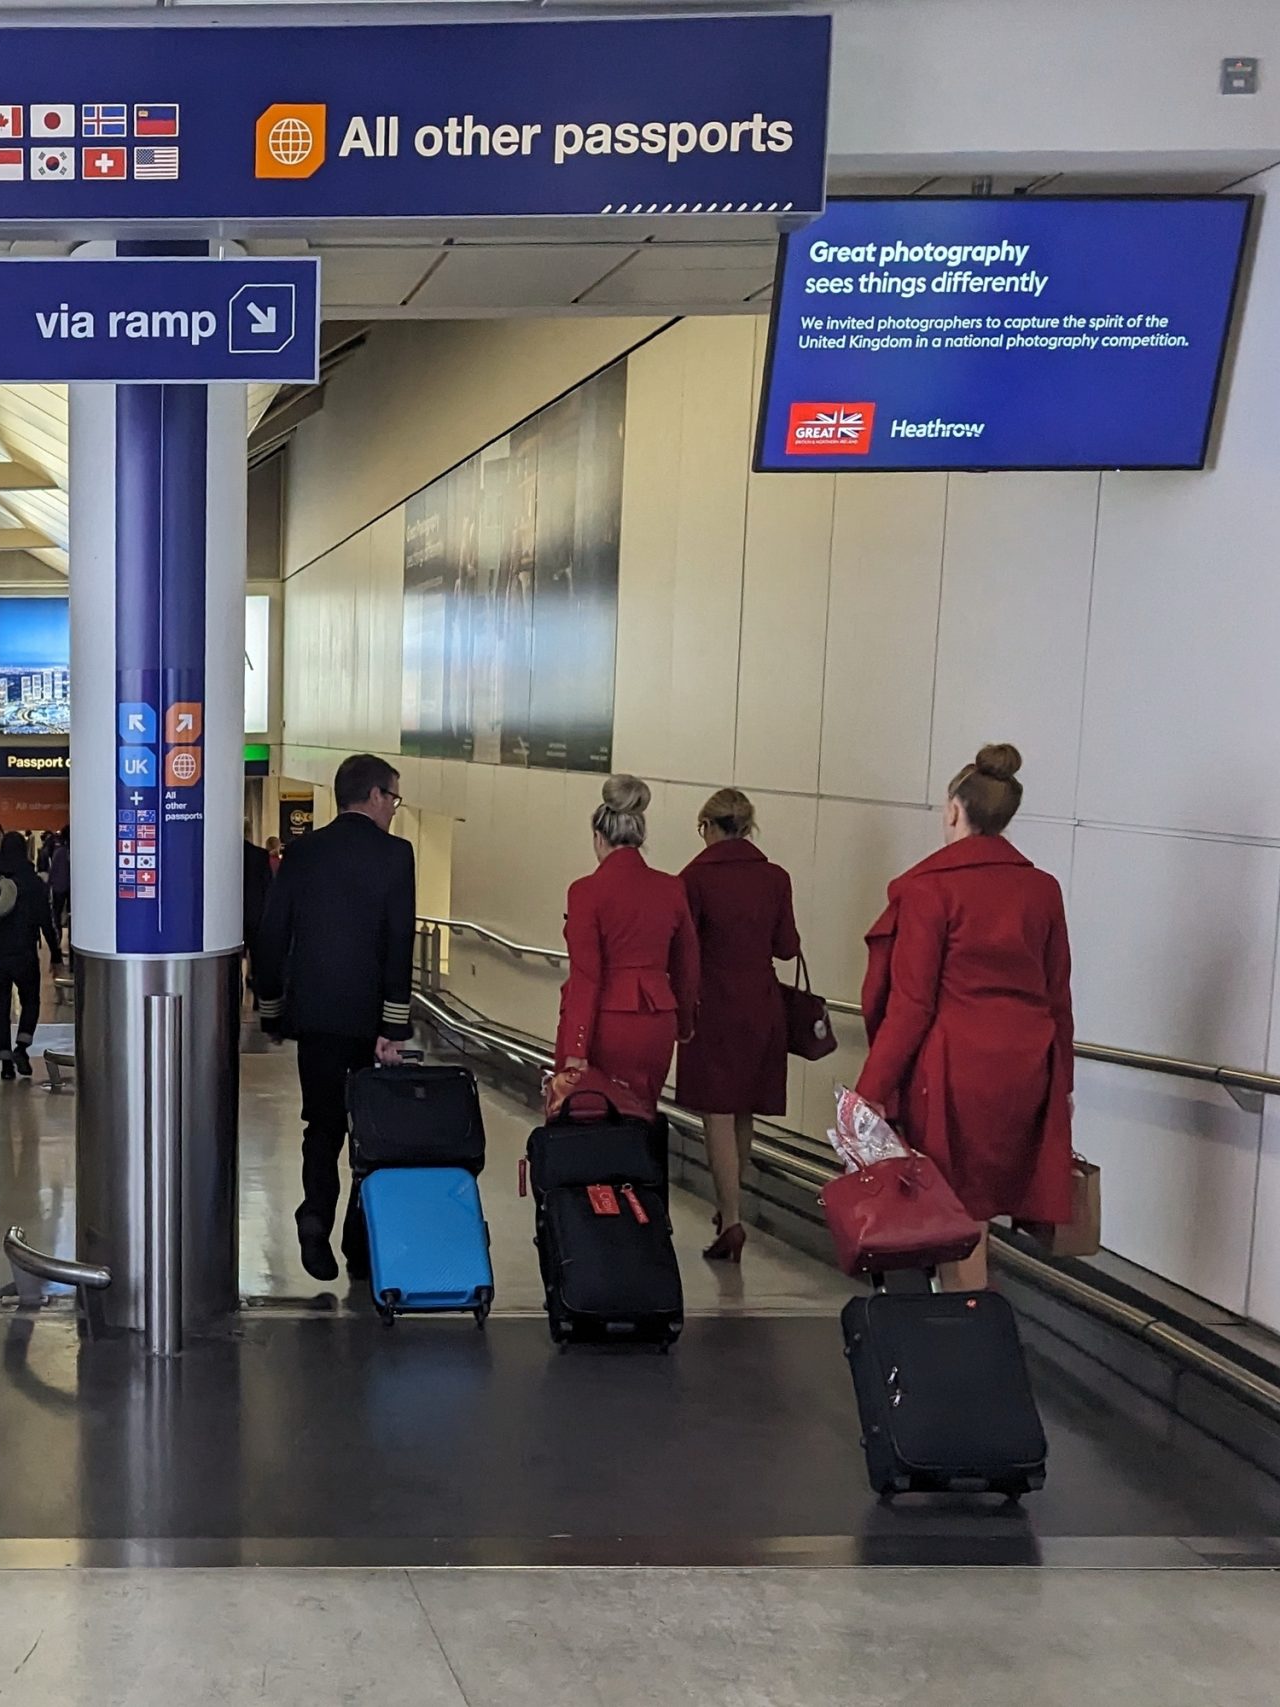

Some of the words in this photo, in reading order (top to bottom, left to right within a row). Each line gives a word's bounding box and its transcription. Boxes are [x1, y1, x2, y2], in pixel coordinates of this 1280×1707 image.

[339, 116, 399, 157] All
[414, 114, 541, 157] other
[554, 112, 794, 164] passports
[809, 241, 877, 264] Great
[879, 240, 1030, 267] photography
[805, 274, 853, 294] sees
[858, 272, 927, 297] things
[931, 271, 1049, 298] differently
[35, 303, 94, 339] via
[109, 310, 217, 346] ramp
[801, 317, 824, 330] We
[826, 315, 875, 330] invited
[877, 315, 983, 334] photographers
[985, 316, 1001, 329] to
[1004, 316, 1060, 333] capture
[1062, 314, 1086, 329] the
[1089, 314, 1124, 333] spirit
[1126, 314, 1144, 328] of
[1145, 314, 1168, 328] the
[799, 335, 846, 349] United
[849, 334, 913, 352] Kingdom
[915, 334, 928, 348] in
[931, 337, 942, 348] a
[944, 333, 1003, 349] national
[1006, 333, 1099, 352] photography
[1101, 333, 1189, 351] competition.
[795, 427, 835, 438] GREAT
[890, 419, 985, 439] Heathrow
[7, 755, 63, 769] Passport
[125, 759, 148, 774] UK
[165, 791, 177, 799] All
[165, 801, 187, 810] other
[165, 811, 203, 821] passports
